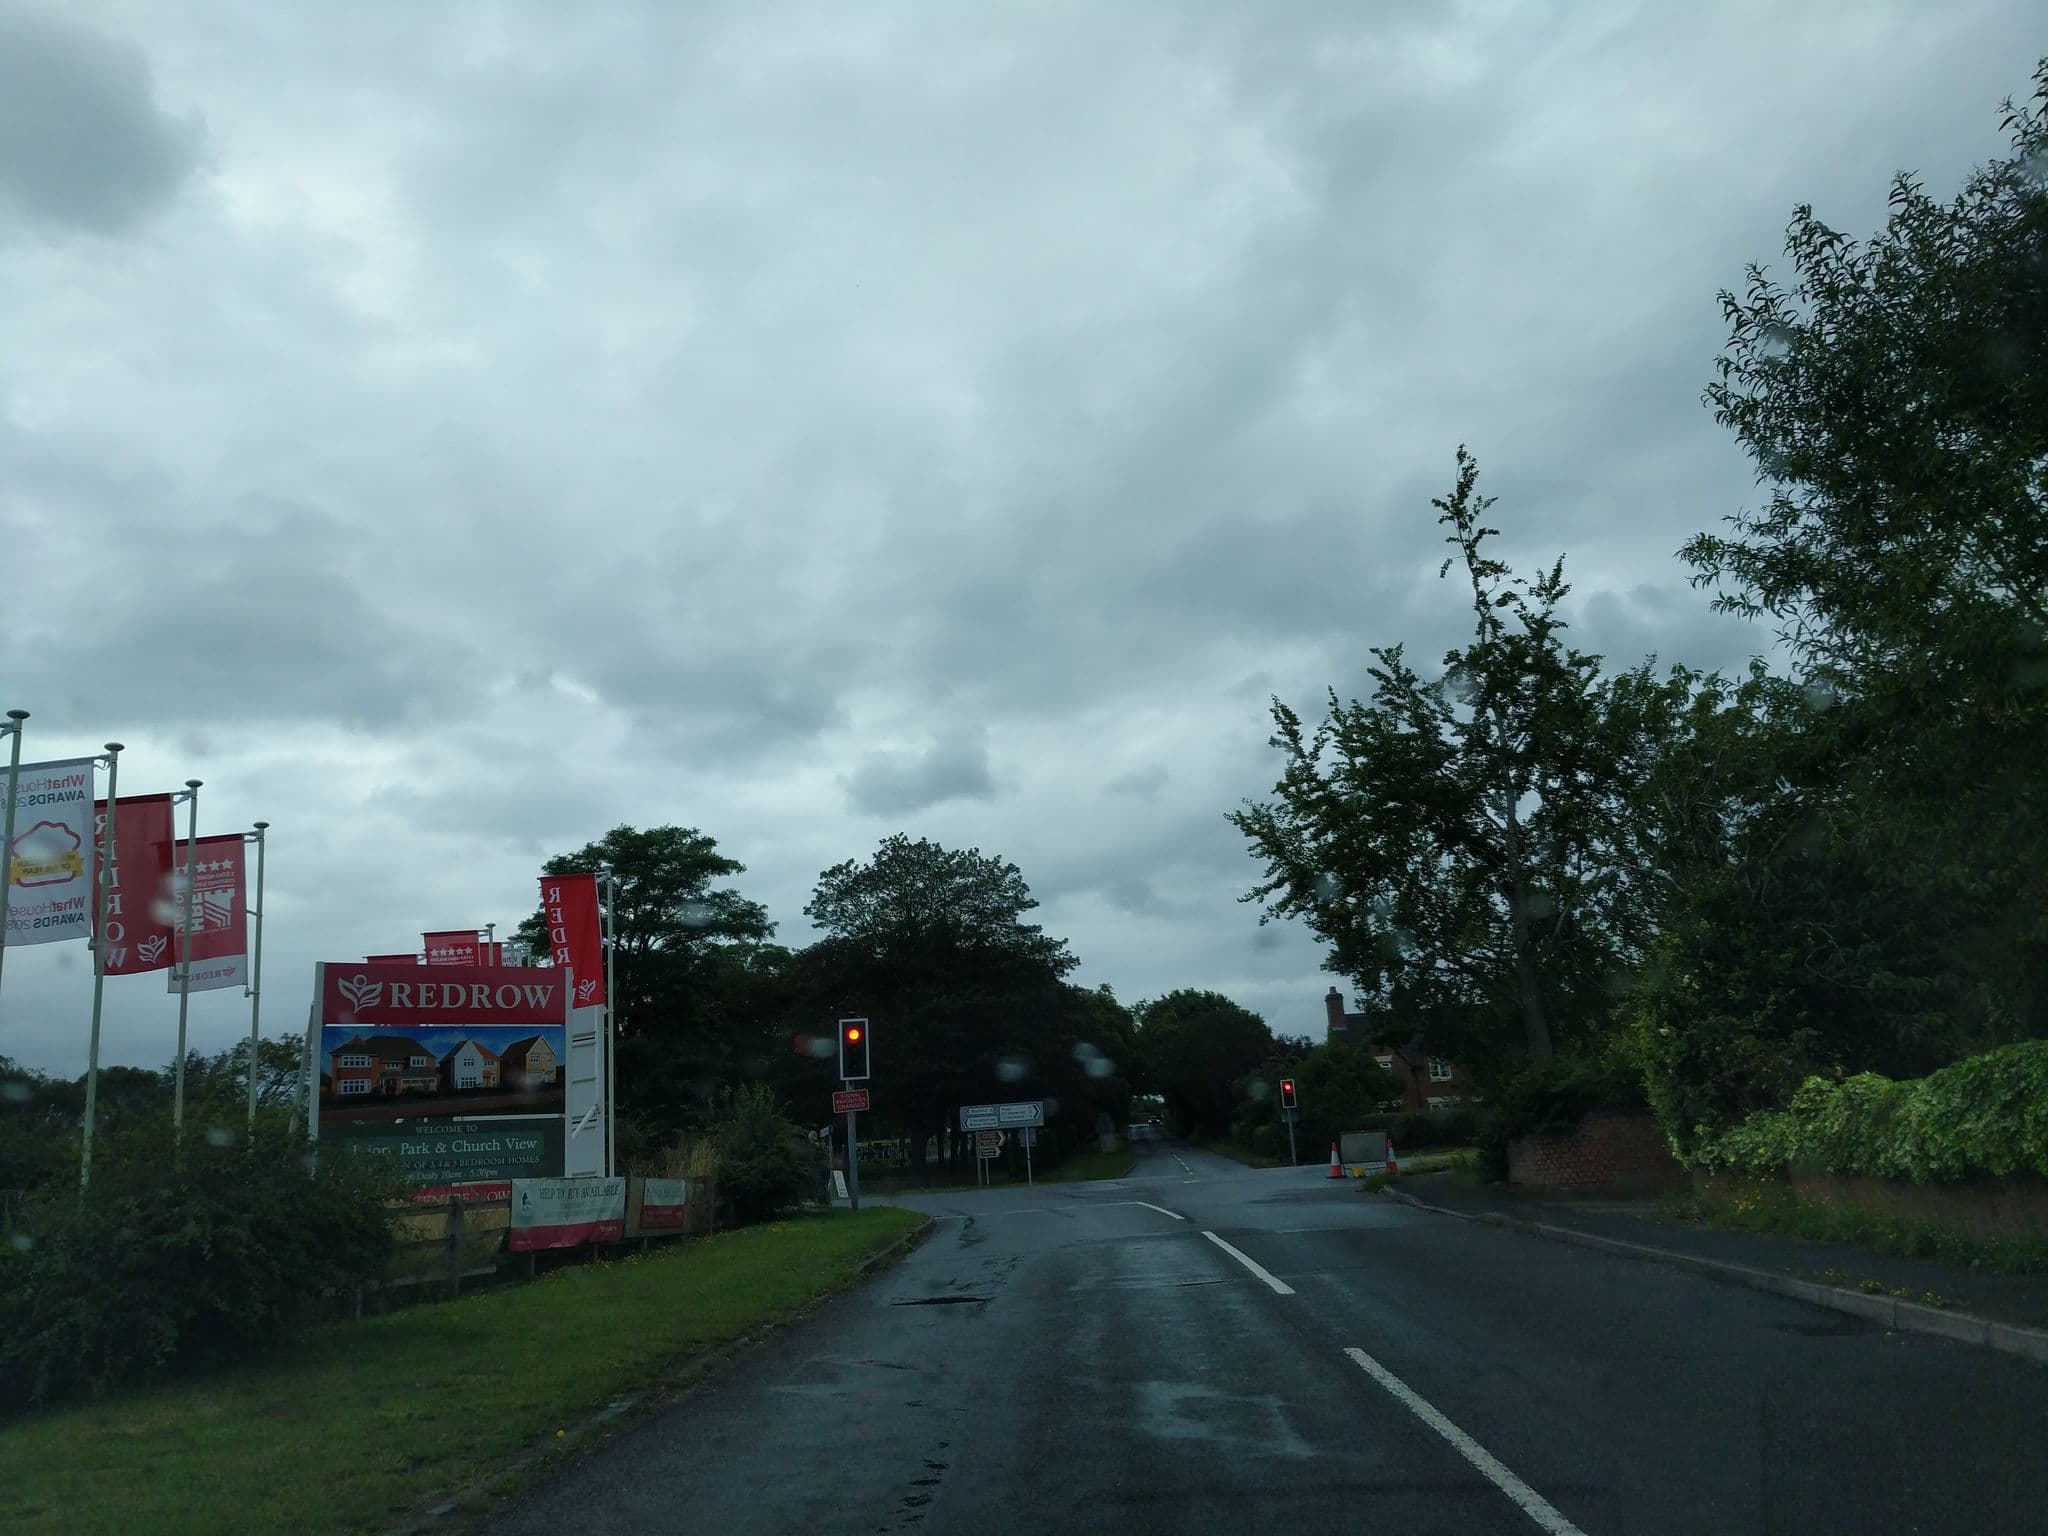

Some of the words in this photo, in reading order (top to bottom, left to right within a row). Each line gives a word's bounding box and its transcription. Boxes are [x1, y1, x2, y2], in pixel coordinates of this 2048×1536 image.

[389, 982, 554, 1009] REDROW
[415, 1125, 462, 1135] WELCOME
[466, 1124, 478, 1132] TO
[400, 1141, 430, 1155] Park
[434, 1142, 447, 1153] &
[452, 1139, 500, 1153] Church
[505, 1137, 538, 1150] View
[460, 1157, 505, 1167] BEDROOM
[508, 1155, 541, 1164] HOMES
